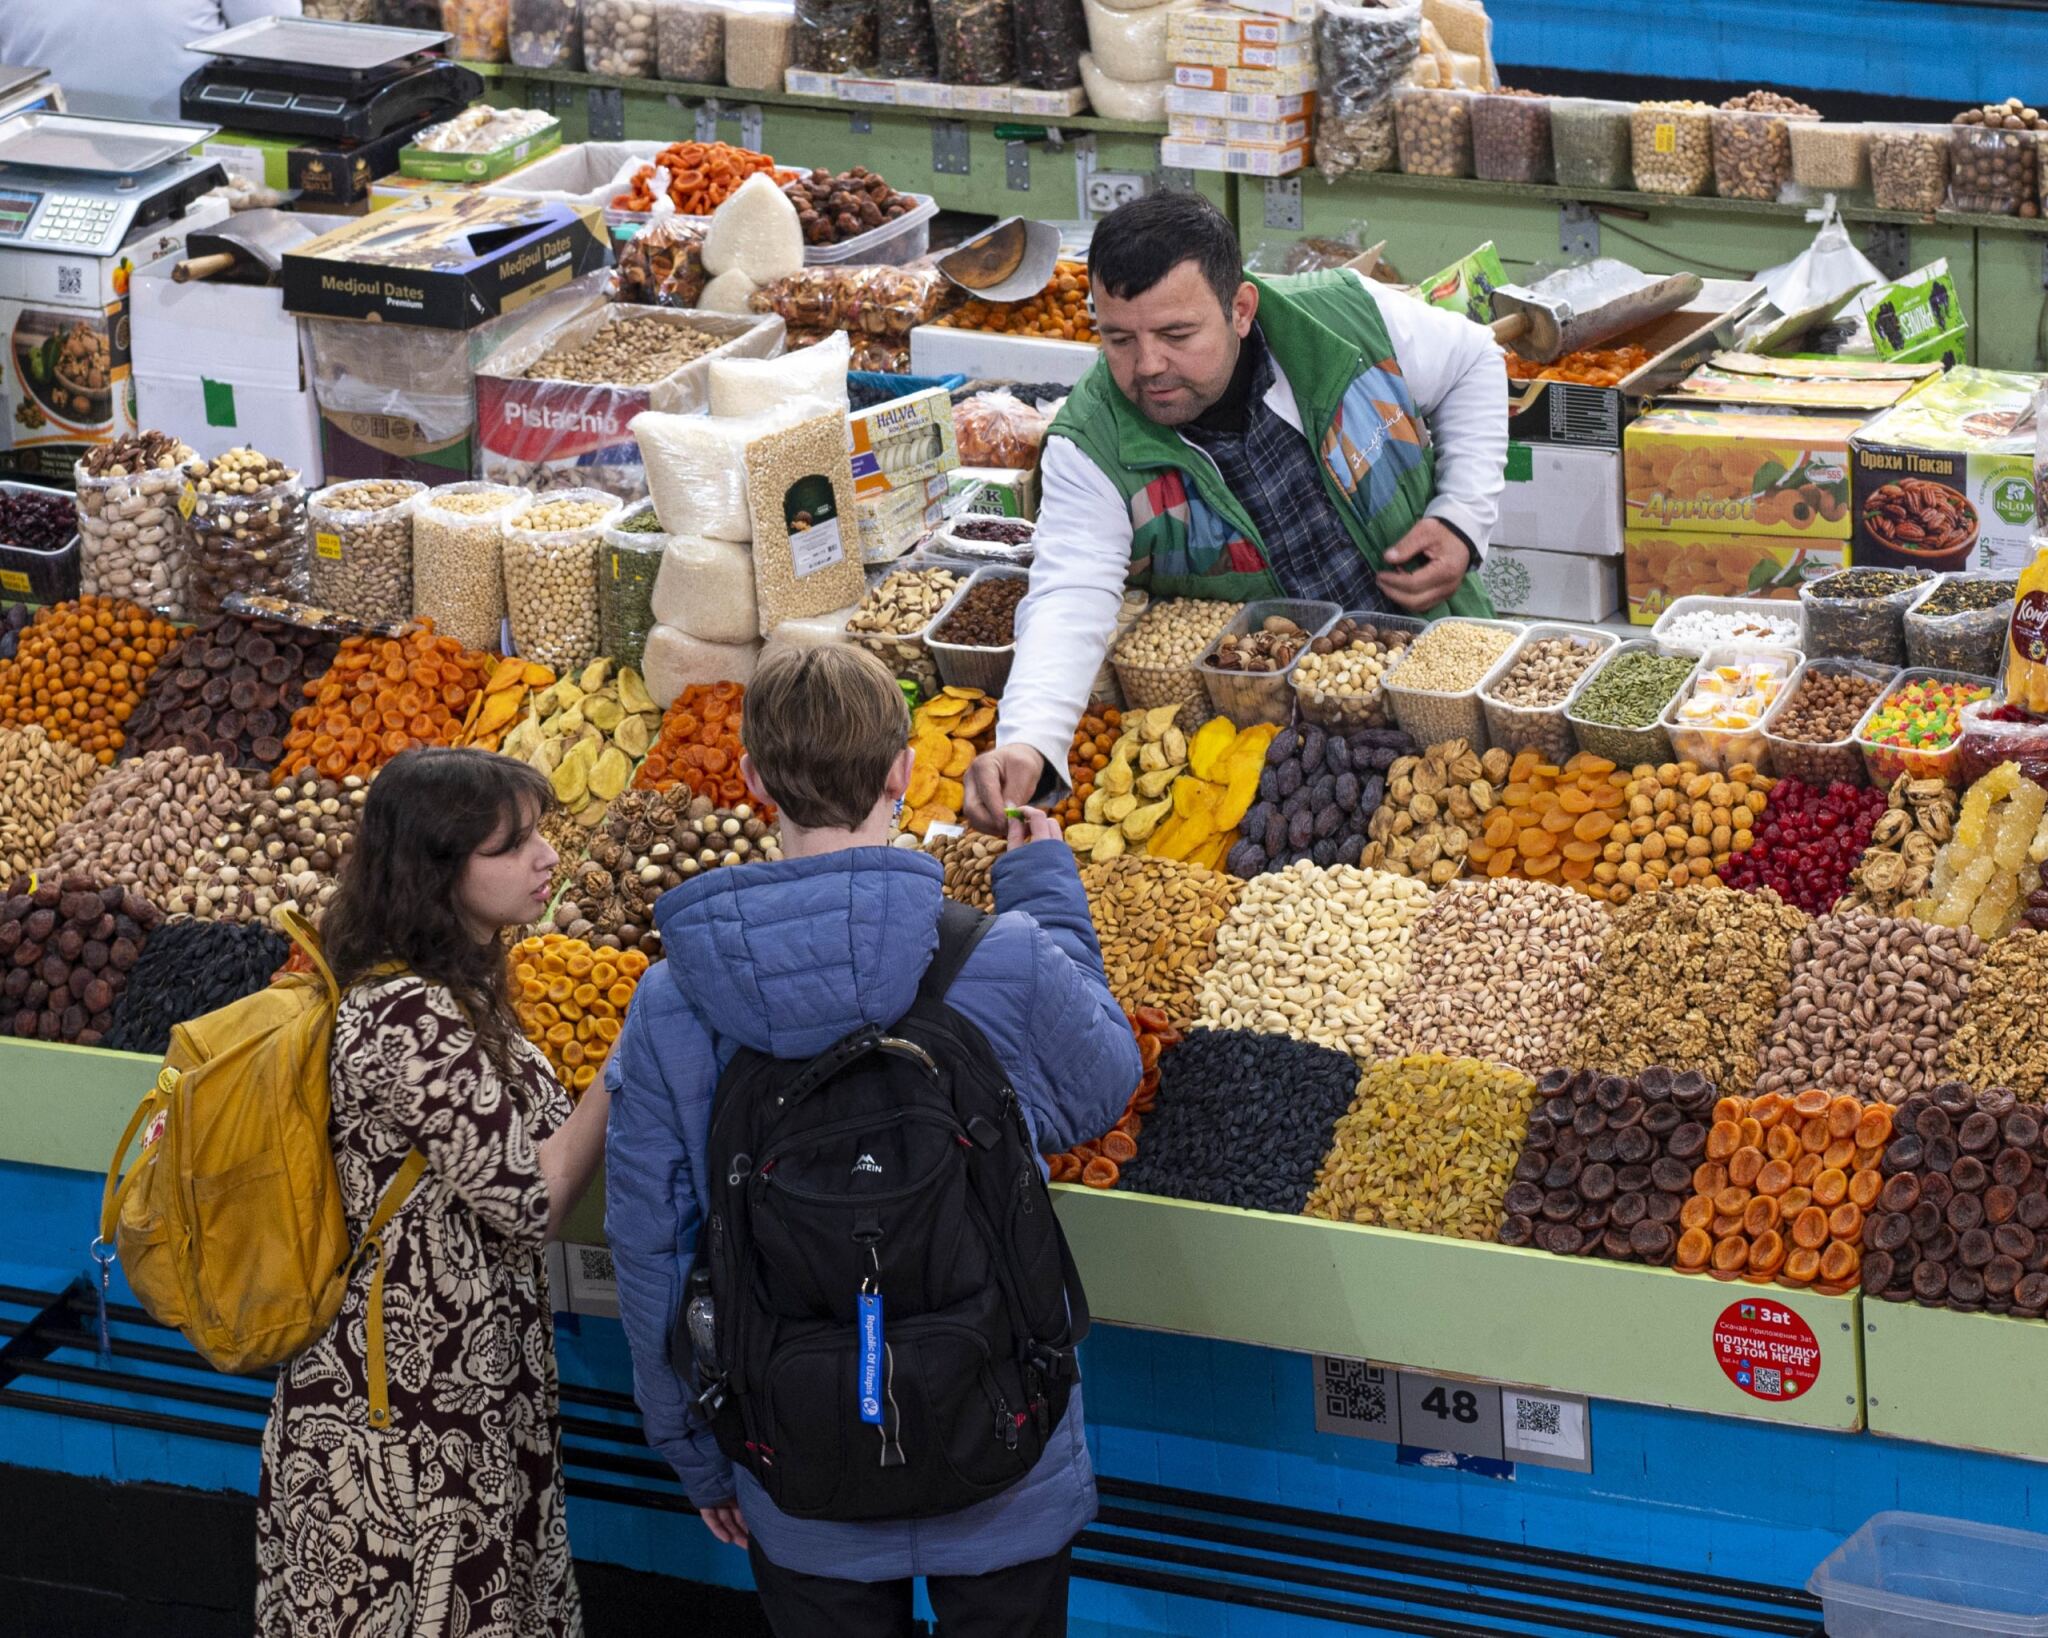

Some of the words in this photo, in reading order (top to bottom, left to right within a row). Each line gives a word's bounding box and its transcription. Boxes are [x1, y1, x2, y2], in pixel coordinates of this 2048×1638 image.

[500, 249, 541, 279] Medjoul
[543, 236, 572, 261] Dates
[321, 275, 380, 296] Medjoul
[384, 282, 424, 300] Dates
[386, 297, 423, 310] Premium
[503, 401, 619, 435] Pistachio
[876, 403, 917, 428] HALVA
[1860, 450, 1902, 470] Орехи
[1906, 454, 1953, 475] Пекан
[1640, 491, 1756, 526] Apricot
[1996, 500, 2034, 513] ISLOM
[865, 1314, 877, 1351] Republic
[1719, 1321, 1748, 1332] Скачай
[1749, 1327, 1797, 1341] приложение
[1715, 1333, 1766, 1350] ПОЛУЧИ
[1769, 1342, 1818, 1359] СКИДКУ
[1723, 1344, 1731, 1353] В
[1734, 1345, 1768, 1359] ЭТОМ
[1771, 1352, 1811, 1367] МЕСТЕ
[1421, 1386, 1479, 1424] 48
